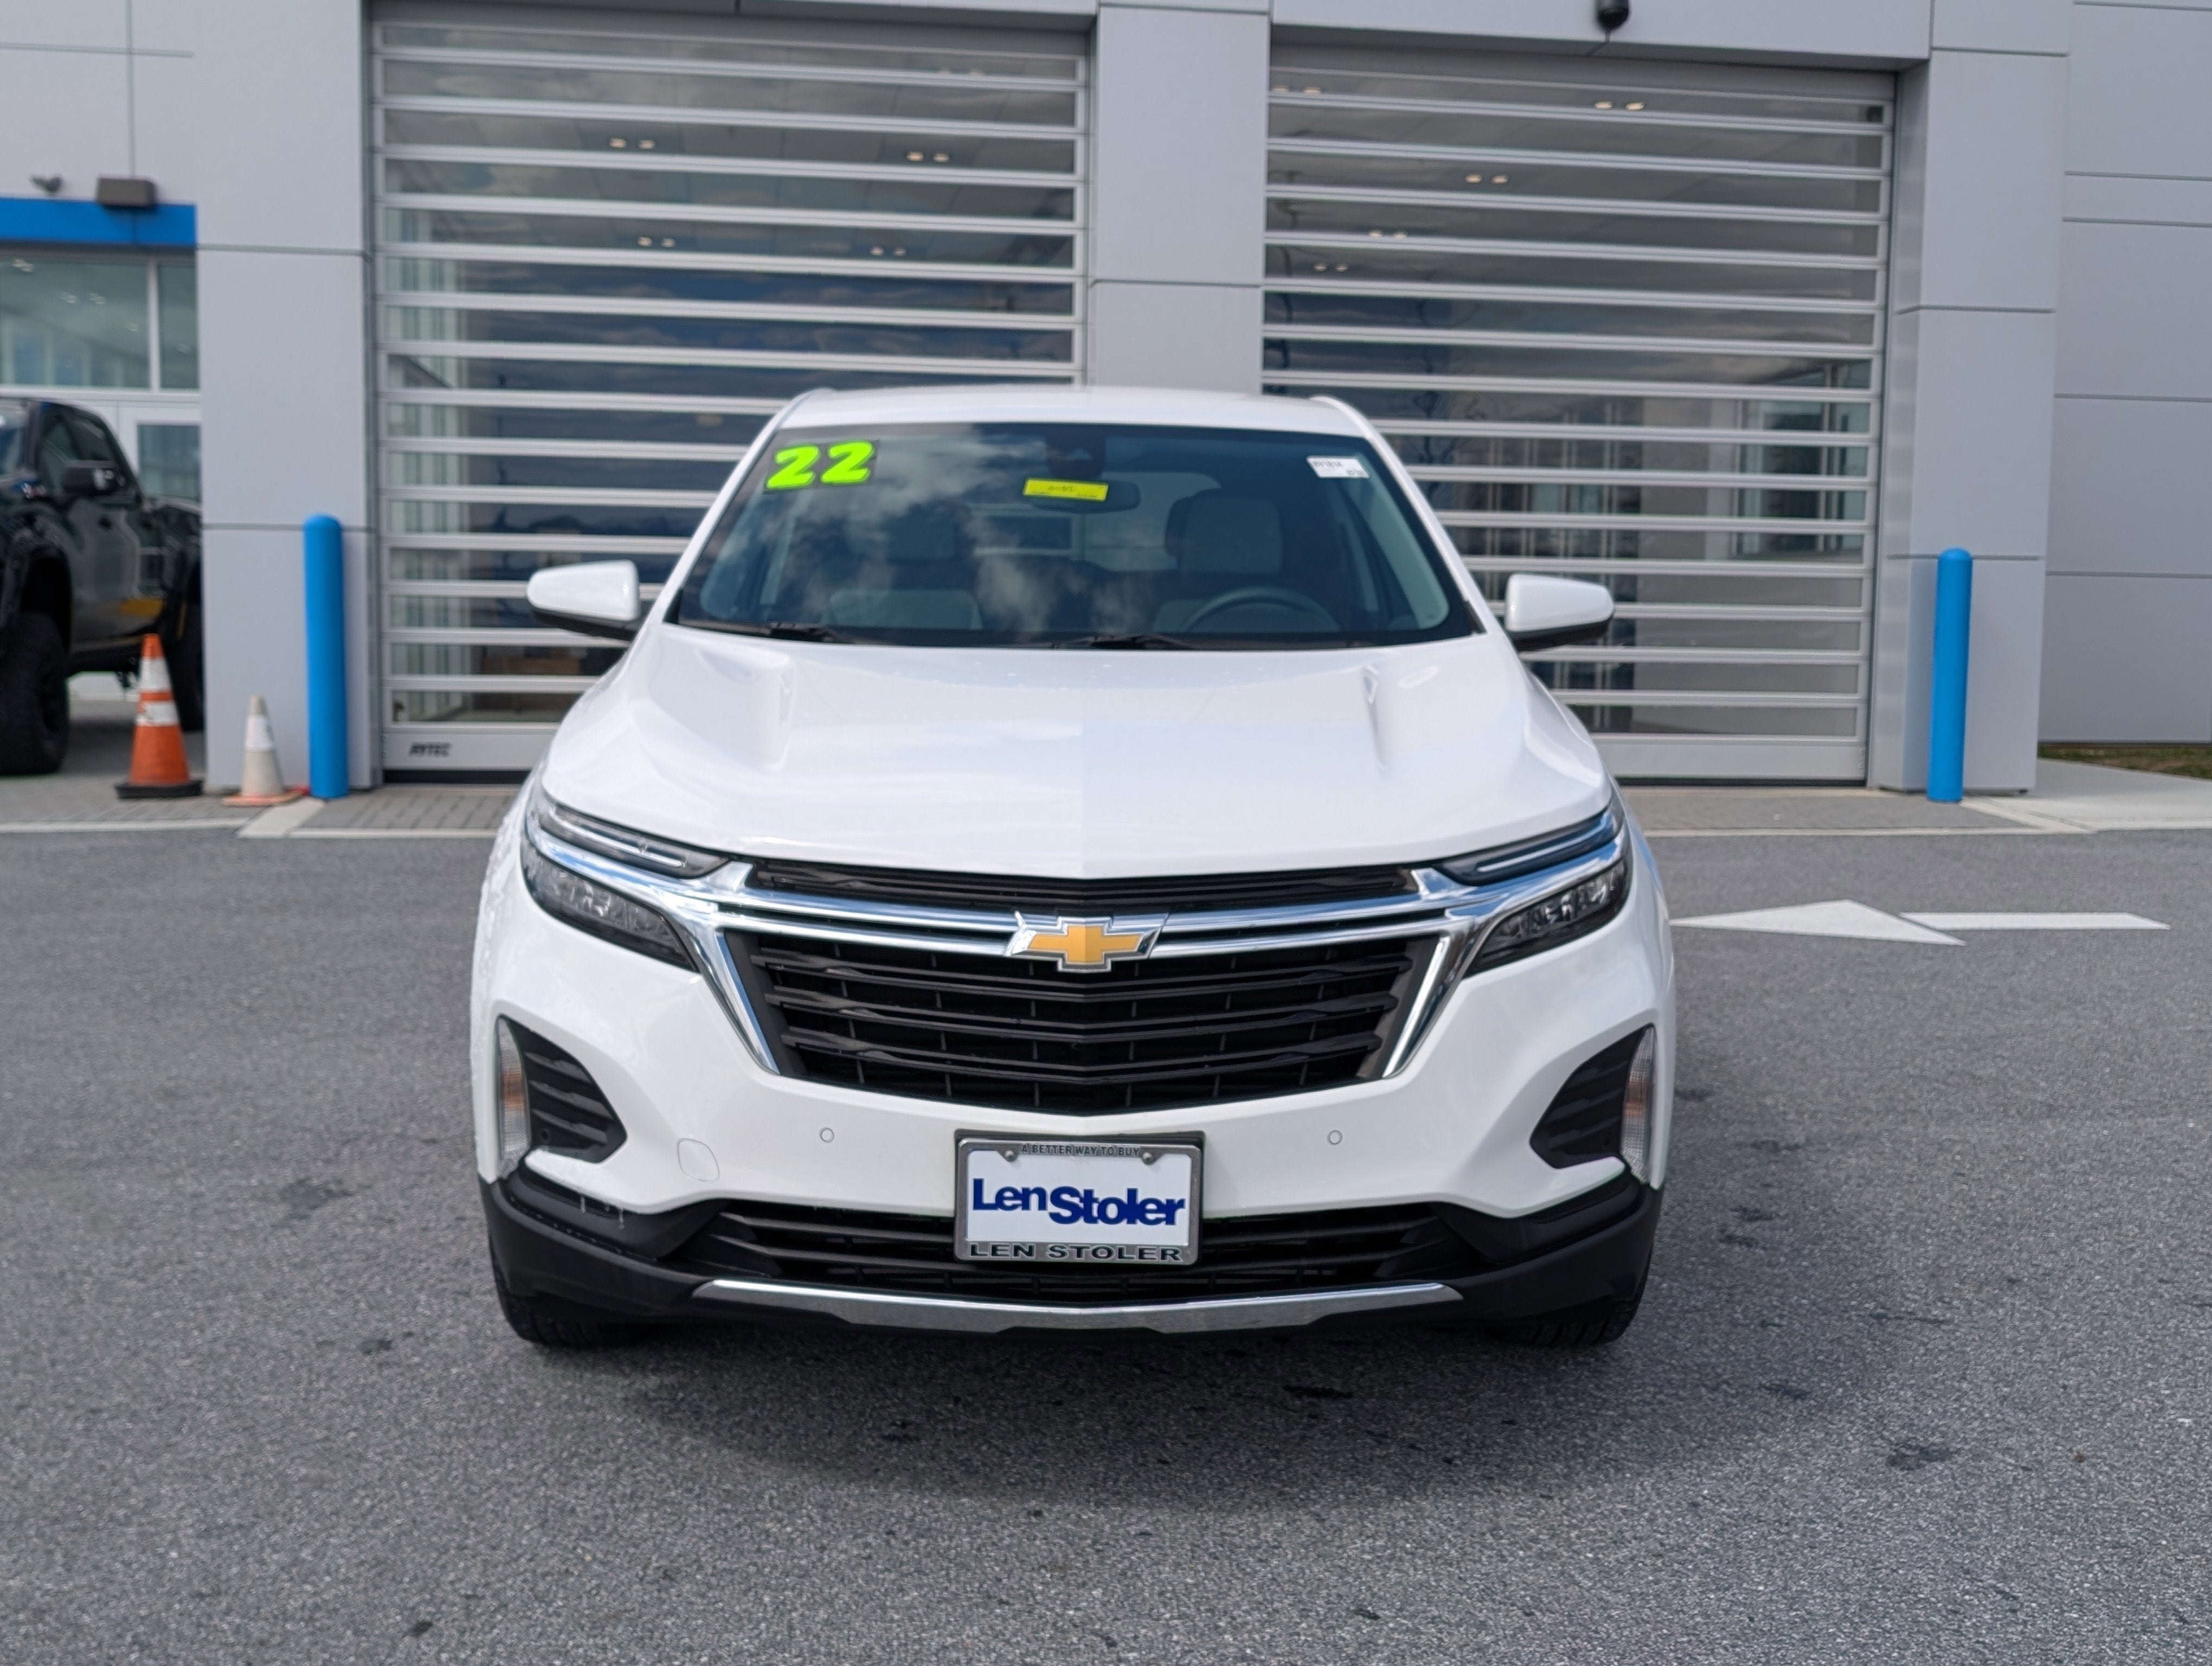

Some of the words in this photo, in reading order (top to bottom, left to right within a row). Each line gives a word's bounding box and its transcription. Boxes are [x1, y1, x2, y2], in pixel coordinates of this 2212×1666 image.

[767, 441, 874, 488] 22
[1021, 1144, 1028, 1154] A
[1031, 1144, 1072, 1155] BETTER
[1075, 1146, 1097, 1155] WAY
[1099, 1147, 1114, 1156] TO
[1117, 1147, 1140, 1156] BUY
[970, 1244, 1036, 1257] LEN
[1047, 1246, 1184, 1261] STOLER
